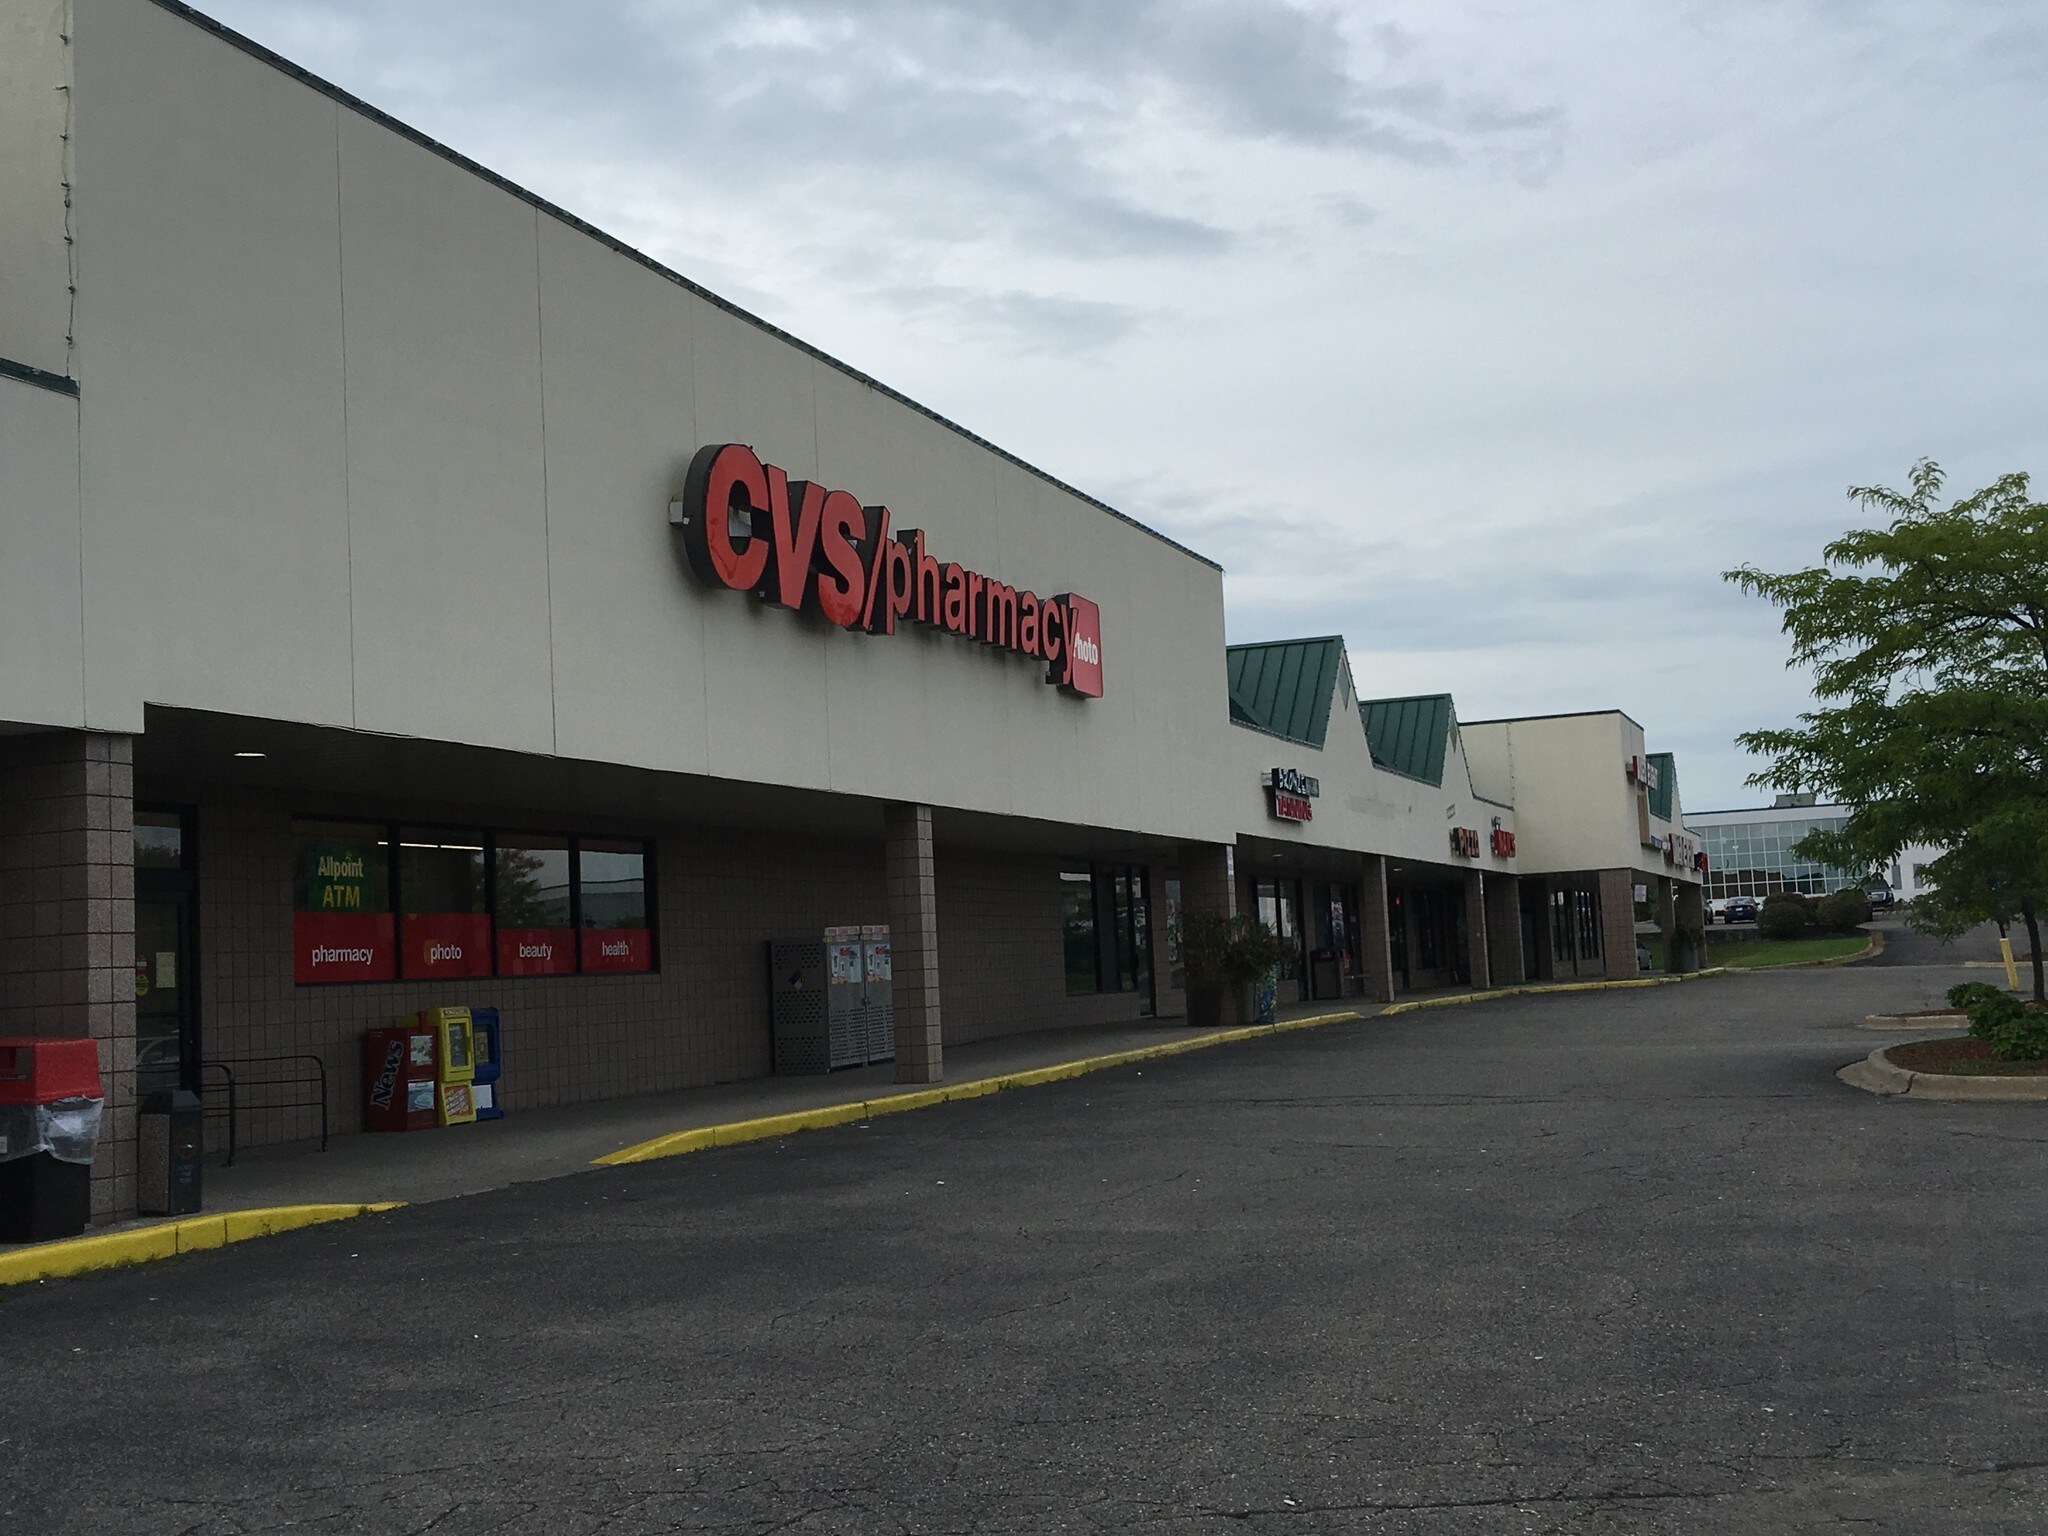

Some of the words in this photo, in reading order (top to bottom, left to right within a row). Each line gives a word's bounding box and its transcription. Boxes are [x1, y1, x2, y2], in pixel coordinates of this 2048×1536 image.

[704, 443, 1078, 684] CVS/pharmacy
[317, 855, 364, 881] Allpoint
[322, 885, 361, 908] ATM
[311, 944, 373, 966] pharmacy
[430, 941, 462, 964] photo
[519, 942, 552, 960] beauty
[602, 941, 629, 957] health
[370, 1040, 404, 1111] News
